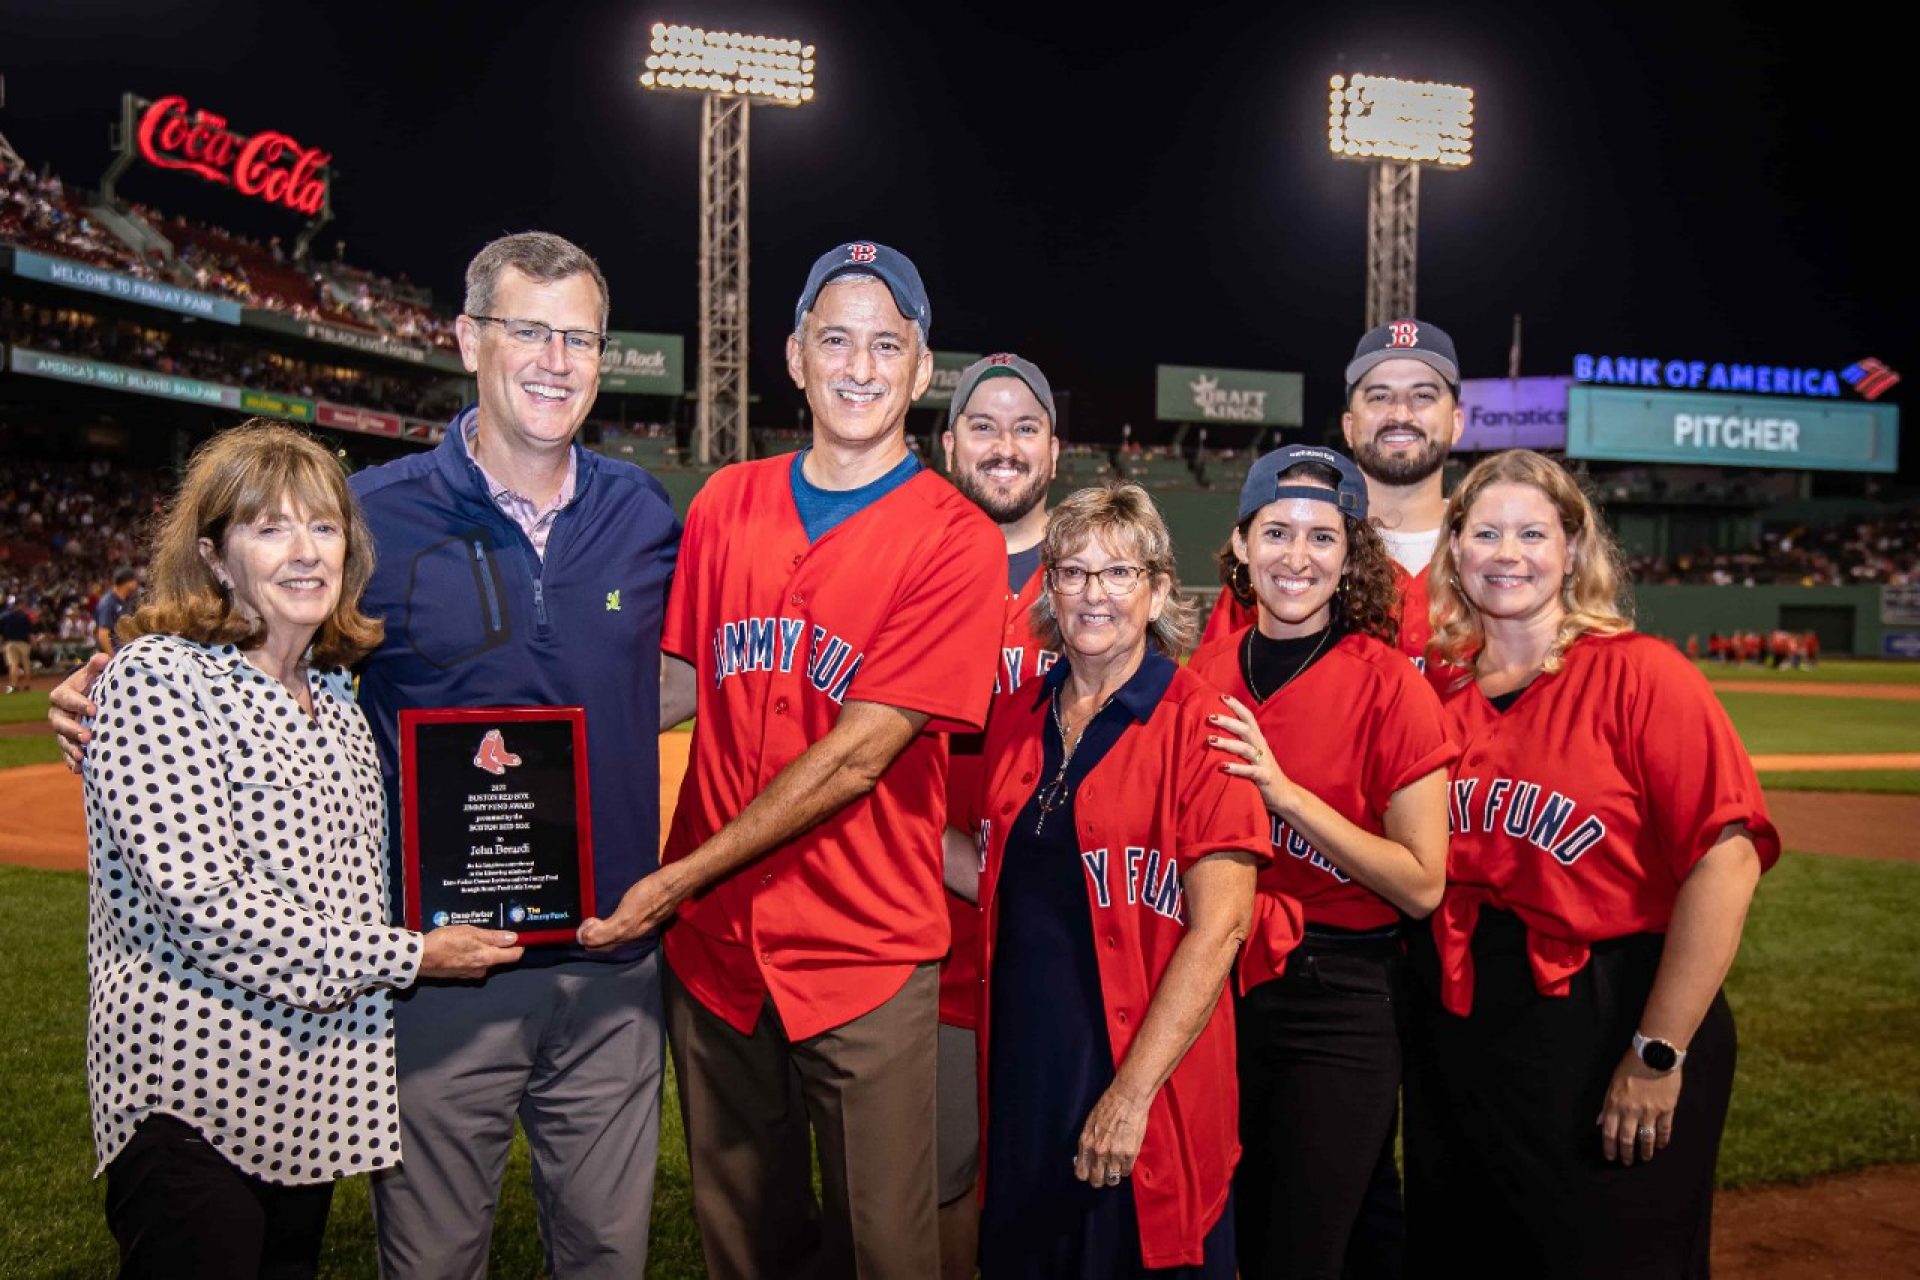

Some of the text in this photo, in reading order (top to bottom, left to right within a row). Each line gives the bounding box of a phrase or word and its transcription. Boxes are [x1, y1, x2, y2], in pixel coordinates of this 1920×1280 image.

[848, 243, 877, 264] B
[52, 264, 111, 291] WELCOME
[117, 279, 130, 294] TO
[1386, 319, 1418, 348] B
[1573, 354, 1841, 397] BANK OF AMERICA
[1470, 406, 1567, 426] Fanatics
[1672, 413, 1800, 452] PITCHER
[1483, 779, 1605, 865] FUND
